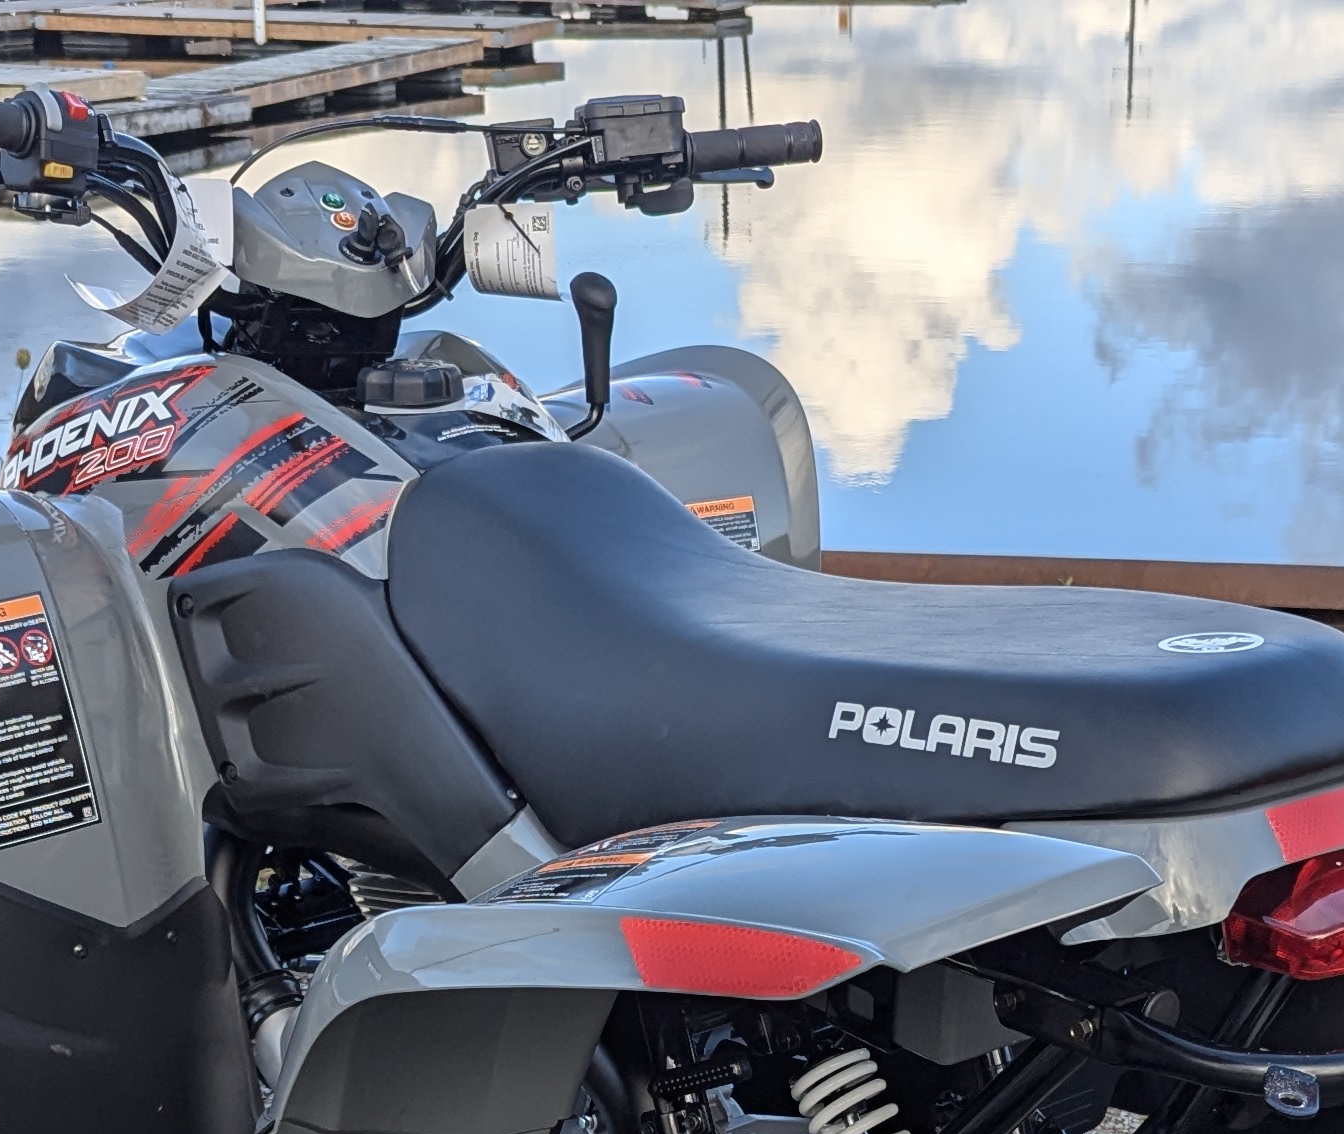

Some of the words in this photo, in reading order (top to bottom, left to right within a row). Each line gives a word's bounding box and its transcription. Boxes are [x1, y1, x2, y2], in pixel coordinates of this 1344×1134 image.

[2, 383, 186, 489] PHOENIX
[74, 425, 175, 485] 200
[697, 502, 735, 514] WARNING
[828, 702, 1060, 769] POLARIS
